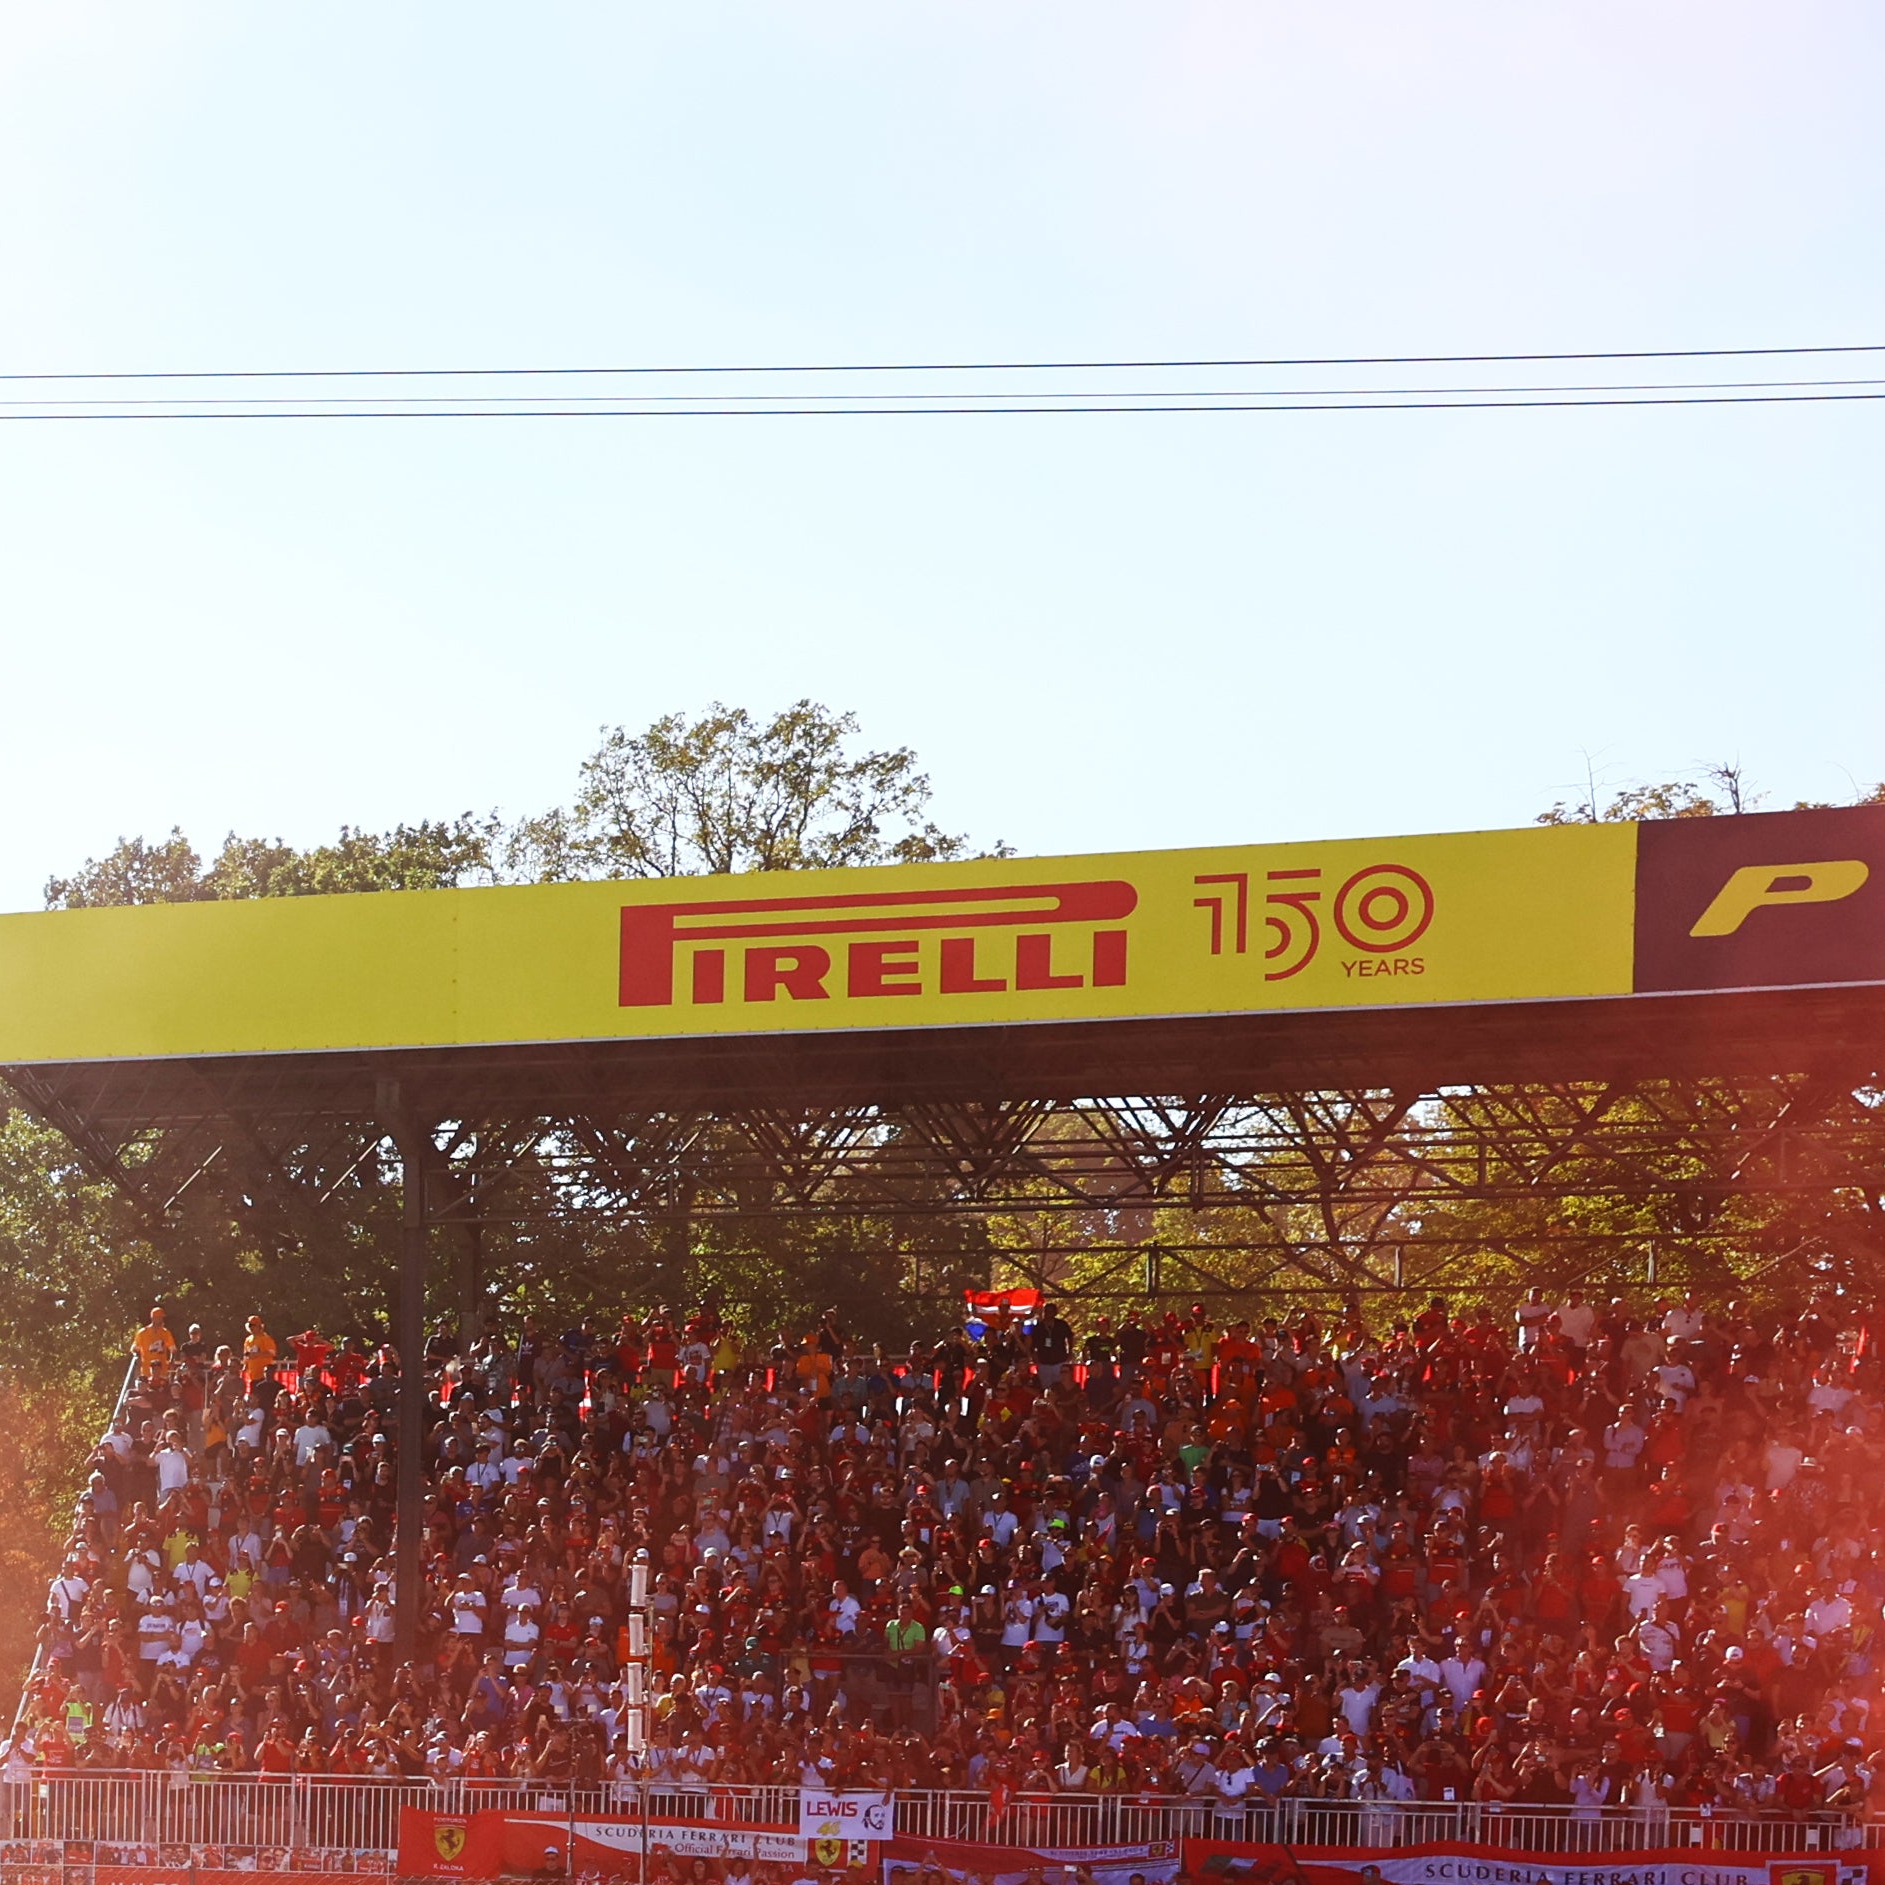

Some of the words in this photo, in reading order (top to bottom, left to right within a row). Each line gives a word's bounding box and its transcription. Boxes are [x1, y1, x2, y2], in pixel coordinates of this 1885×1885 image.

[619, 880, 1139, 1007] PIRELLI
[1193, 864, 1433, 982] 150
[1340, 957, 1426, 979] YEARS
[806, 1800, 859, 1818] LEWIS
[681, 1829, 750, 1844] FERRARI
[674, 1841, 713, 1856] Official
[1425, 1862, 1549, 1884] SCUDERIA
